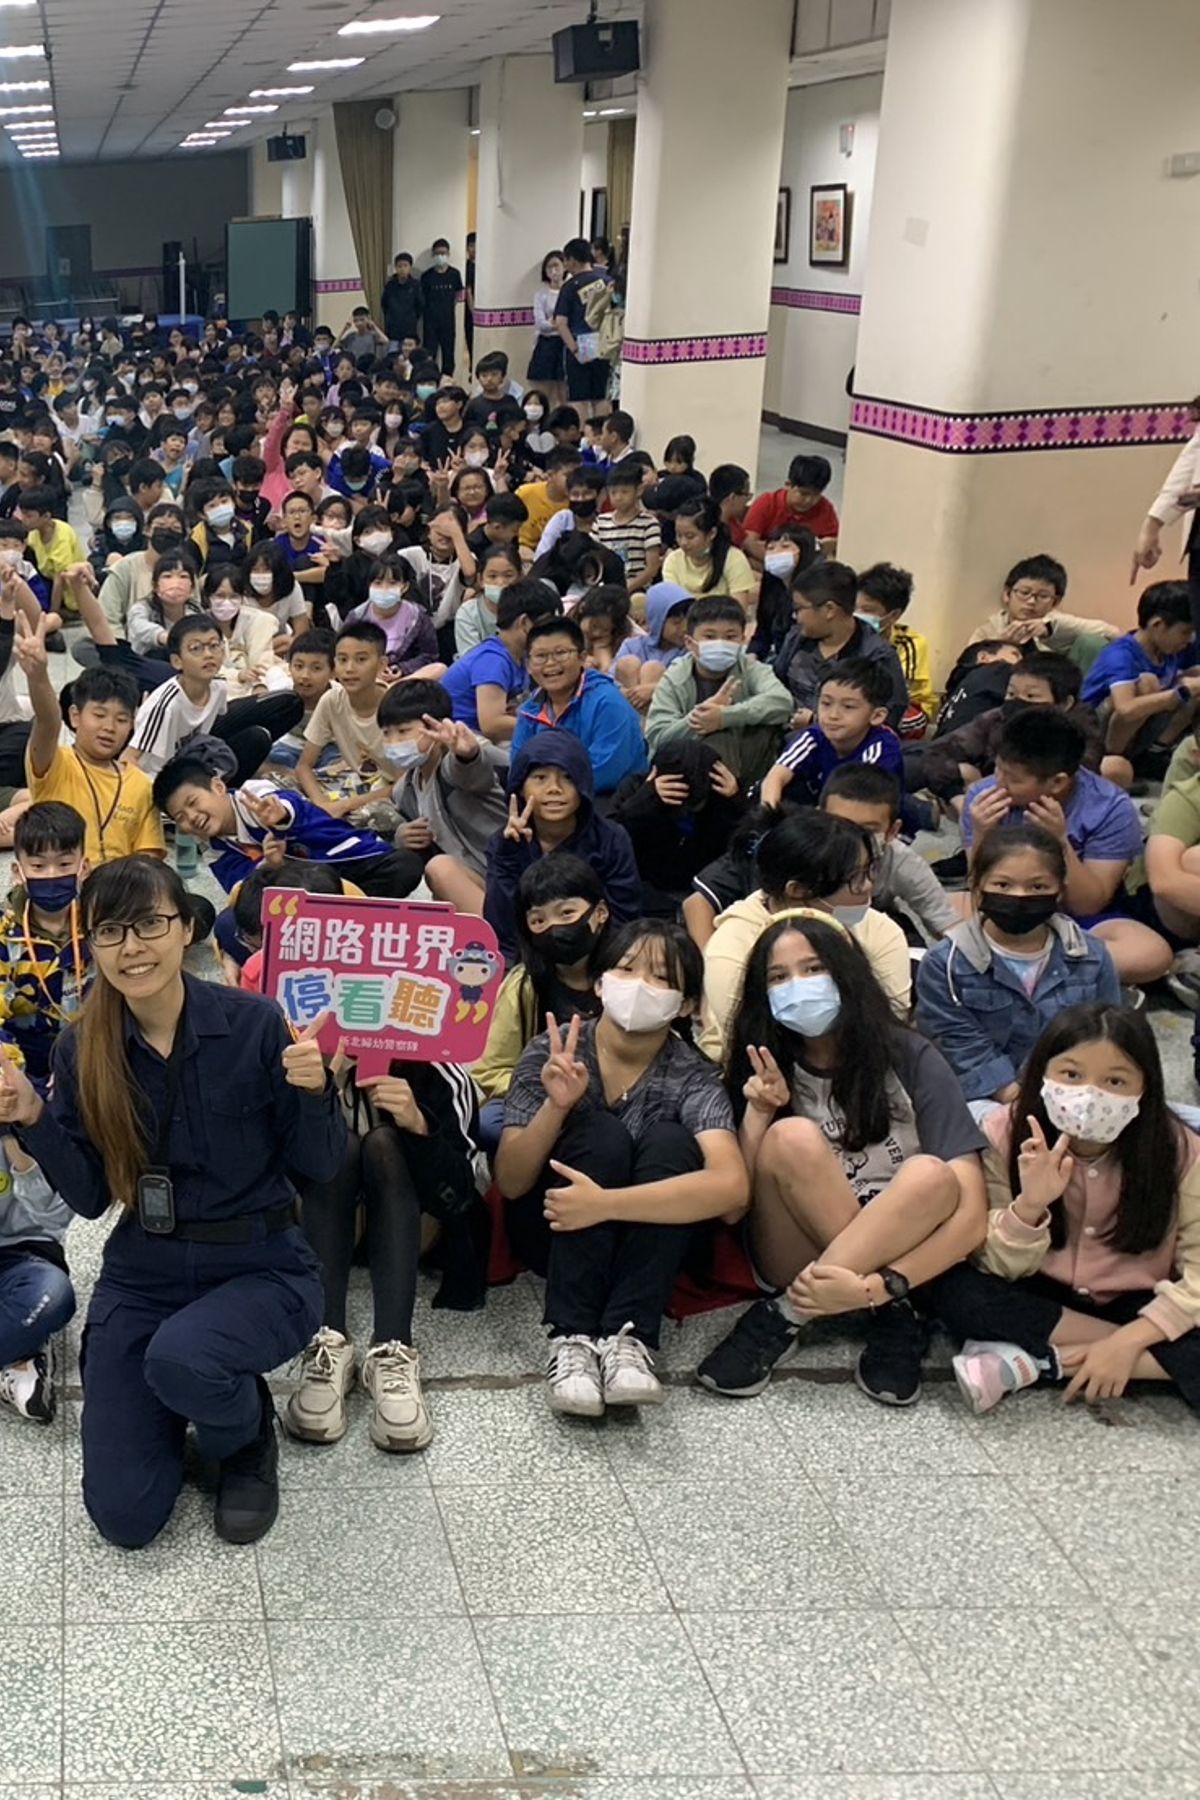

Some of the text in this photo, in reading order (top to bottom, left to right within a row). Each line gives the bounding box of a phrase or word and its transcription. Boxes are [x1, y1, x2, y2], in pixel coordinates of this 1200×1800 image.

[278, 917, 455, 971] 網路世界
[281, 972, 446, 1031] 停看聽
